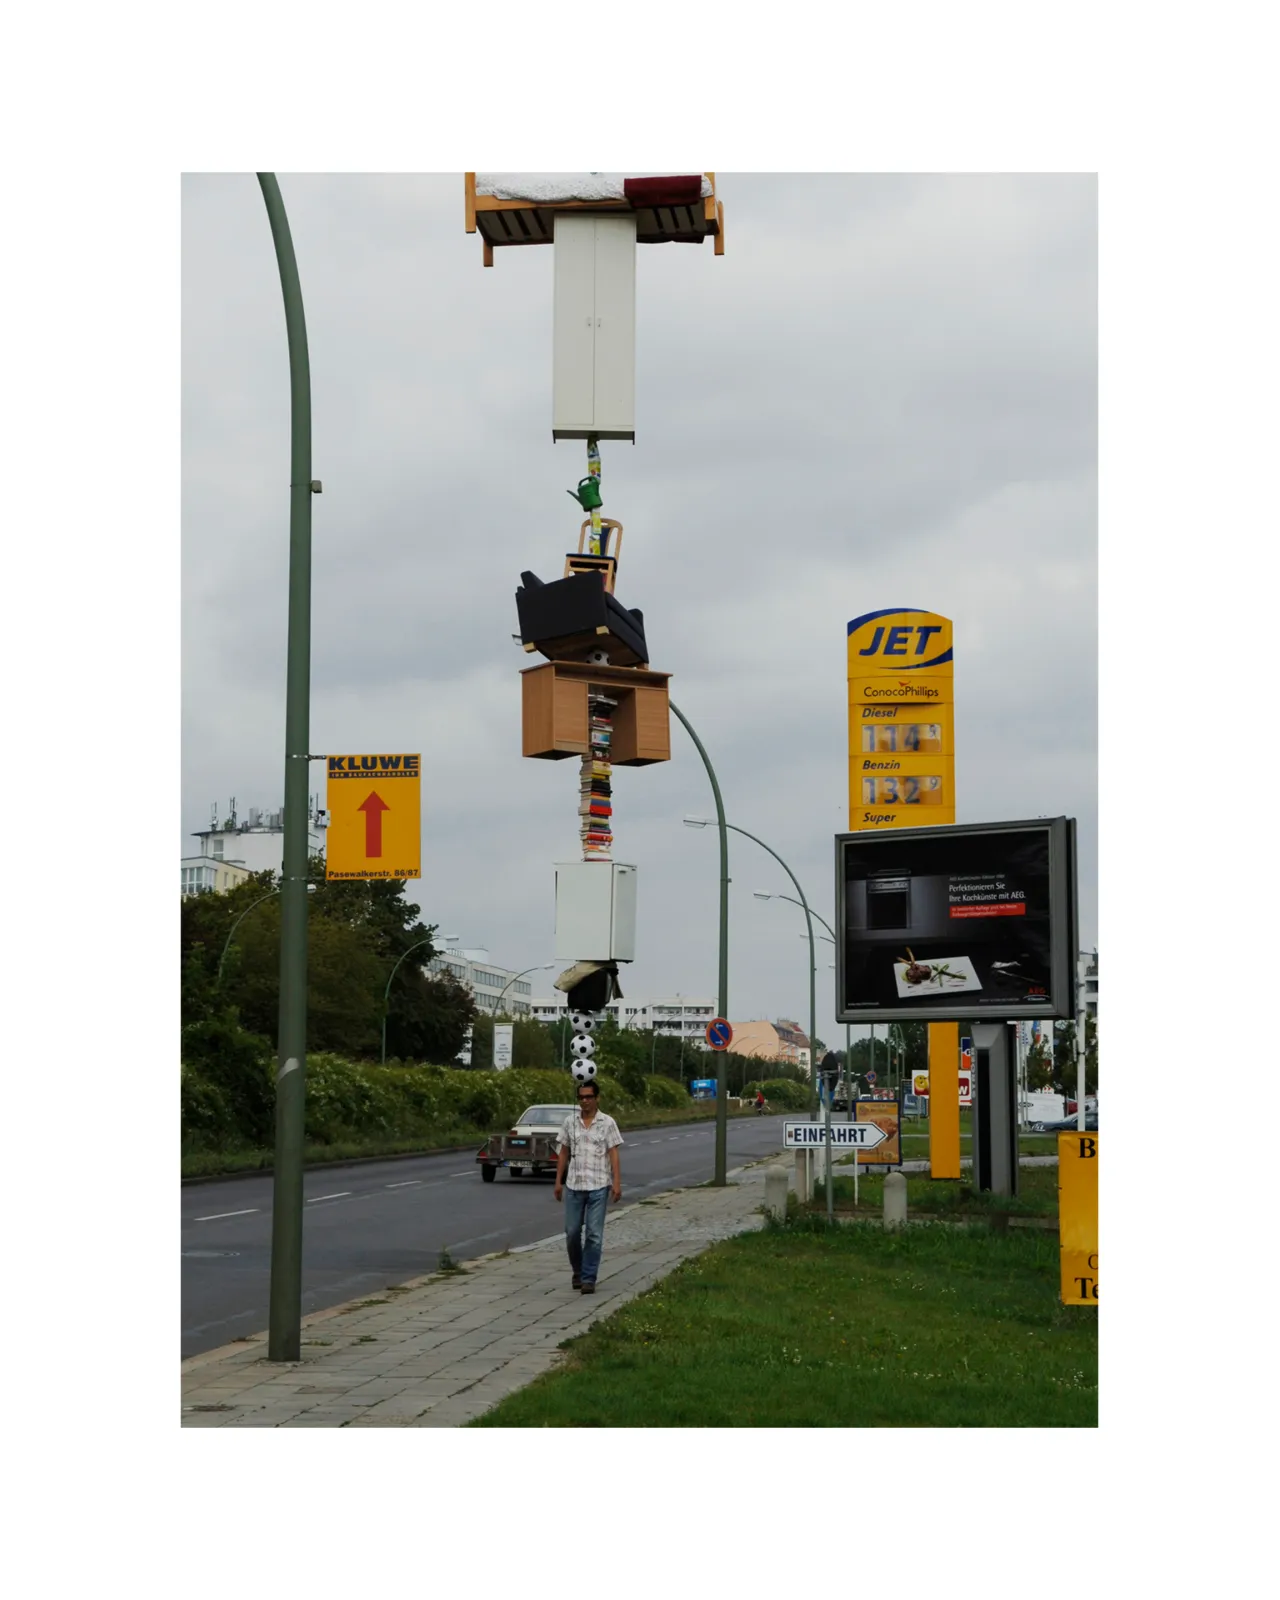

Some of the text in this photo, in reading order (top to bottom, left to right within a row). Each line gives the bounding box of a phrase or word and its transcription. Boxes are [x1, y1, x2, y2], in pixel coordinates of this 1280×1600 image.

[859, 626, 942, 656] JET
[863, 686, 939, 698] ConocoPhillips
[862, 707, 898, 718] Diesel
[329, 756, 419, 771] KLUWE
[862, 760, 901, 770] Benzin
[863, 813, 896, 824] Super
[328, 869, 418, 878] Pasewalkerstr. 86/87
[949, 882, 1006, 892] Perfektionieren Sie
[962, 893, 998, 902] Kochkünste
[1010, 891, 1026, 899] AEG.
[794, 1128, 867, 1142] EINFAHRT
